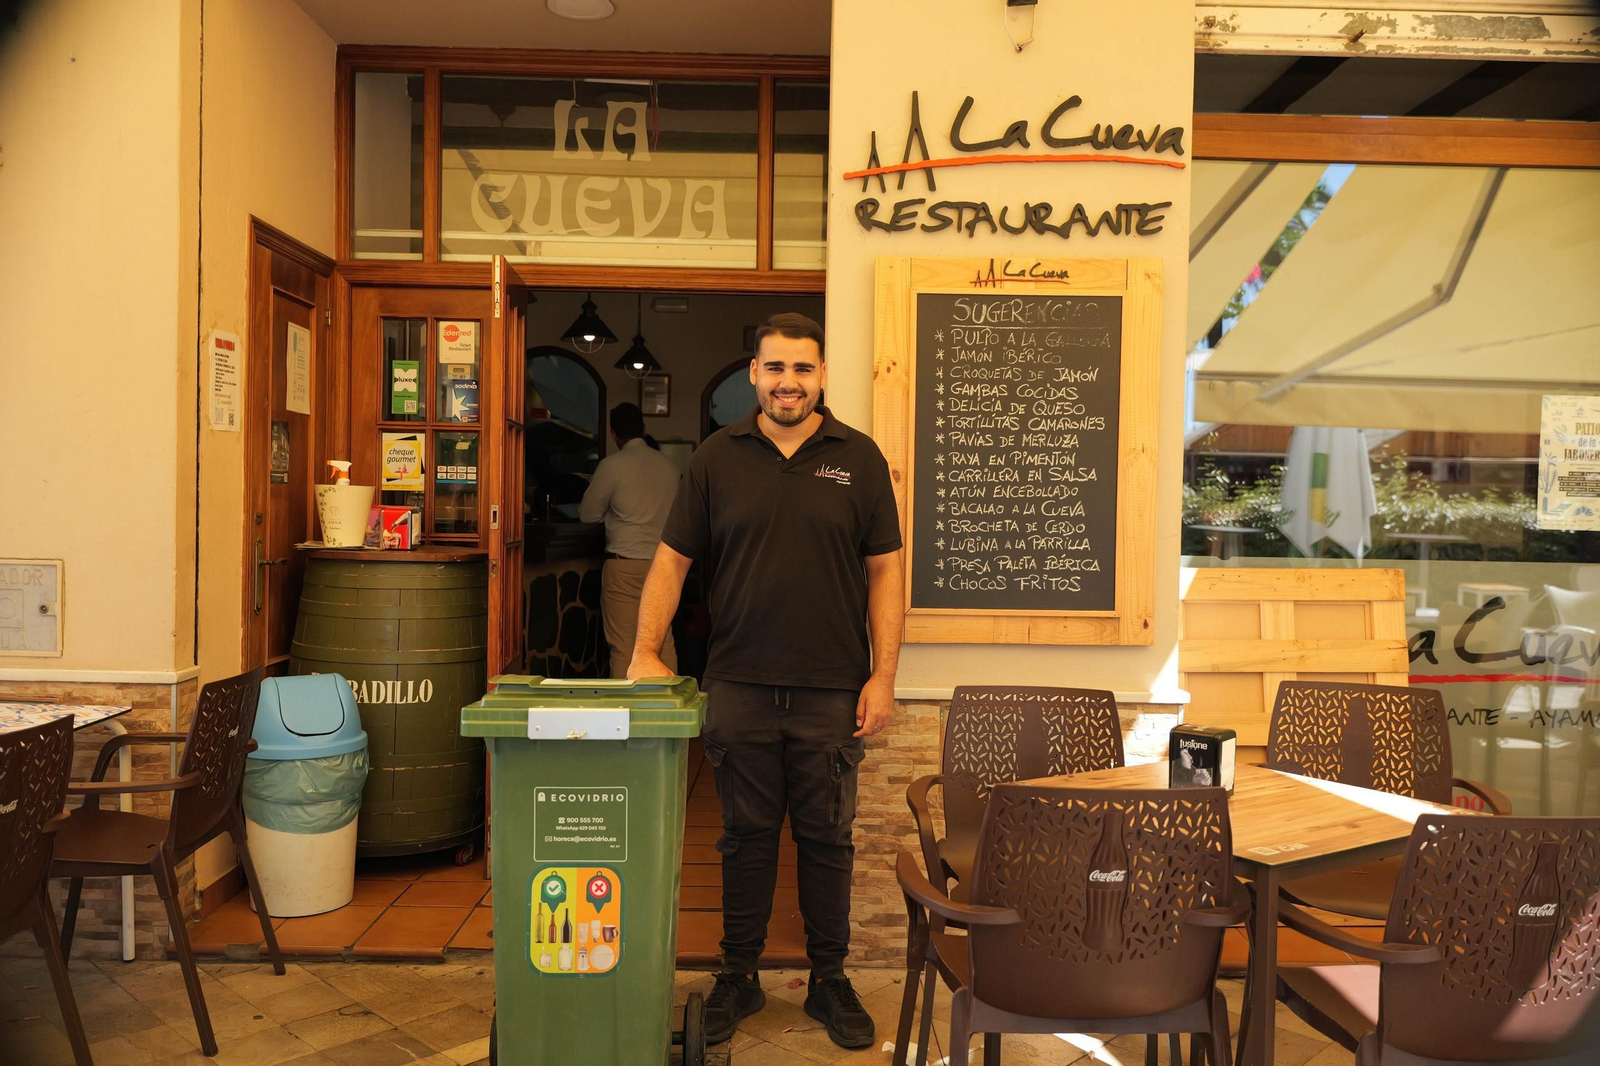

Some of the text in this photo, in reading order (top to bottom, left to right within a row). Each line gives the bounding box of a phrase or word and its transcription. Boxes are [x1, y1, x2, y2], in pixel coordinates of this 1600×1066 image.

[552, 99, 652, 162] LA
[950, 96, 1030, 152] La
[1042, 95, 1184, 155] Cueva
[471, 174, 730, 240] CUEVA
[854, 198, 1172, 238] RESTAURANTE
[1003, 259, 1025, 277] La
[1029, 263, 1069, 279] Cueva
[951, 329, 999, 346] PULPO
[1008, 332, 1015, 345] A
[1022, 331, 1036, 346] LA
[951, 346, 992, 363] JAMÓN
[950, 365, 1099, 382] CROQUETAS DE JAMÓN
[950, 382, 1008, 397] GAMBAS
[1010, 402, 1026, 415] DE
[1033, 400, 1085, 416] QUESO
[1028, 416, 1106, 430] CAMARONES
[1575, 423, 1600, 435] PATIO
[1000, 435, 1014, 447] DE
[1022, 434, 1079, 448] MERLUZA
[389, 448, 414, 456] cheque
[949, 452, 980, 466] RAYA
[989, 455, 1005, 465] EN
[1028, 470, 1042, 482] EN
[1049, 467, 1097, 482] SALSA
[950, 485, 1078, 500] ATÚN ENCEBOLLADO
[948, 500, 1085, 517] BACALAO A LA CUEVA
[947, 519, 1085, 535] BROCHETA DE CERDO
[1005, 540, 1012, 550] A
[1015, 539, 1026, 550] LA
[947, 554, 1100, 574] PRESA PALETA IBÉRICA
[949, 574, 1007, 591] CHOCOS
[1089, 870, 1126, 882] Coca-Cola
[1518, 904, 1557, 916] Coca-Cola
